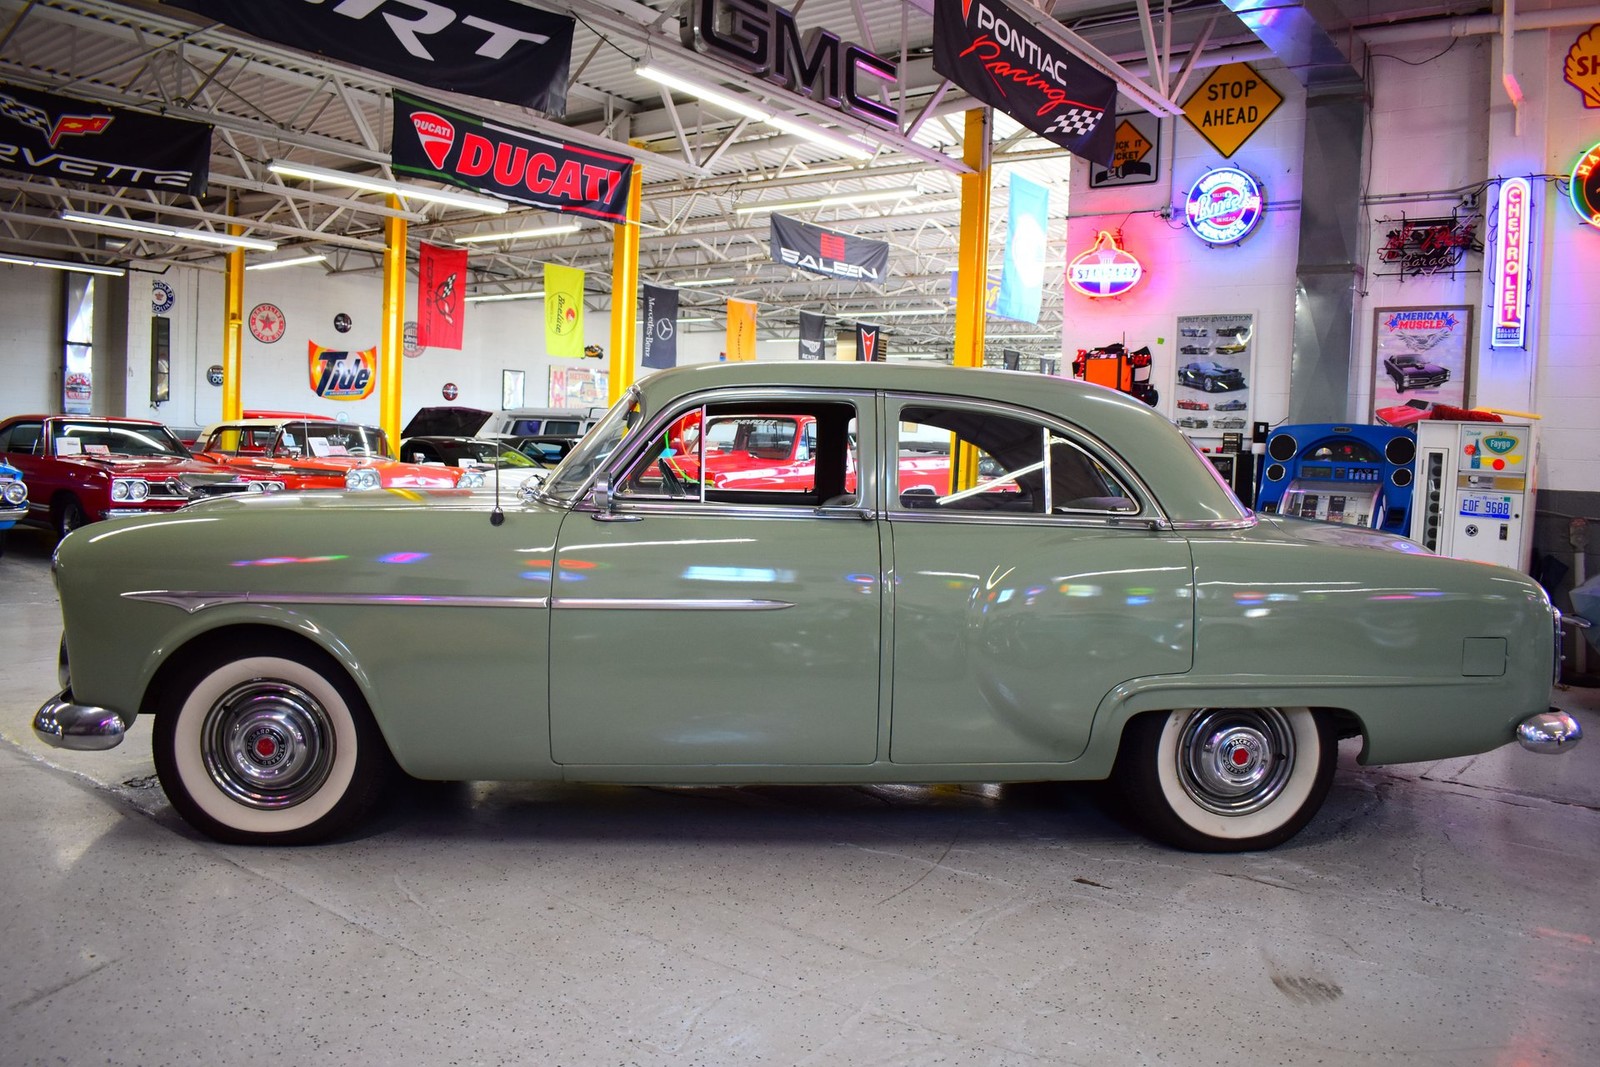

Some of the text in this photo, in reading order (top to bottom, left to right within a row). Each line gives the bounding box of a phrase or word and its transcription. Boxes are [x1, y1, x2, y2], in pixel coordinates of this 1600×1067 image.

[310, 0, 551, 61] RT
[977, 3, 1067, 87] PONTIAC
[686, 0, 899, 131] GMC
[959, 34, 1105, 117] Racing
[1207, 80, 1257, 101] STOP
[414, 118, 450, 138] DUCATI
[1202, 106, 1258, 127] AHEAD
[1134, 139, 1143, 148] IT
[456, 132, 622, 204] DUCATI
[780, 247, 879, 279] SALEEN
[1504, 187, 1521, 320] CHEVROLET
[151, 283, 174, 299] NDARD
[556, 294, 566, 334] Beeline
[1395, 311, 1449, 321] AMERICAN
[1399, 320, 1443, 330] MUSCLE
[644, 296, 656, 357] Mercedes-Benz
[316, 351, 371, 398] Tide
[1490, 440, 1511, 449] Faygo
[1462, 499, 1509, 515] EDF 9688
[247, 728, 270, 751] PACKARD
[262, 743, 286, 765] PACKARD
